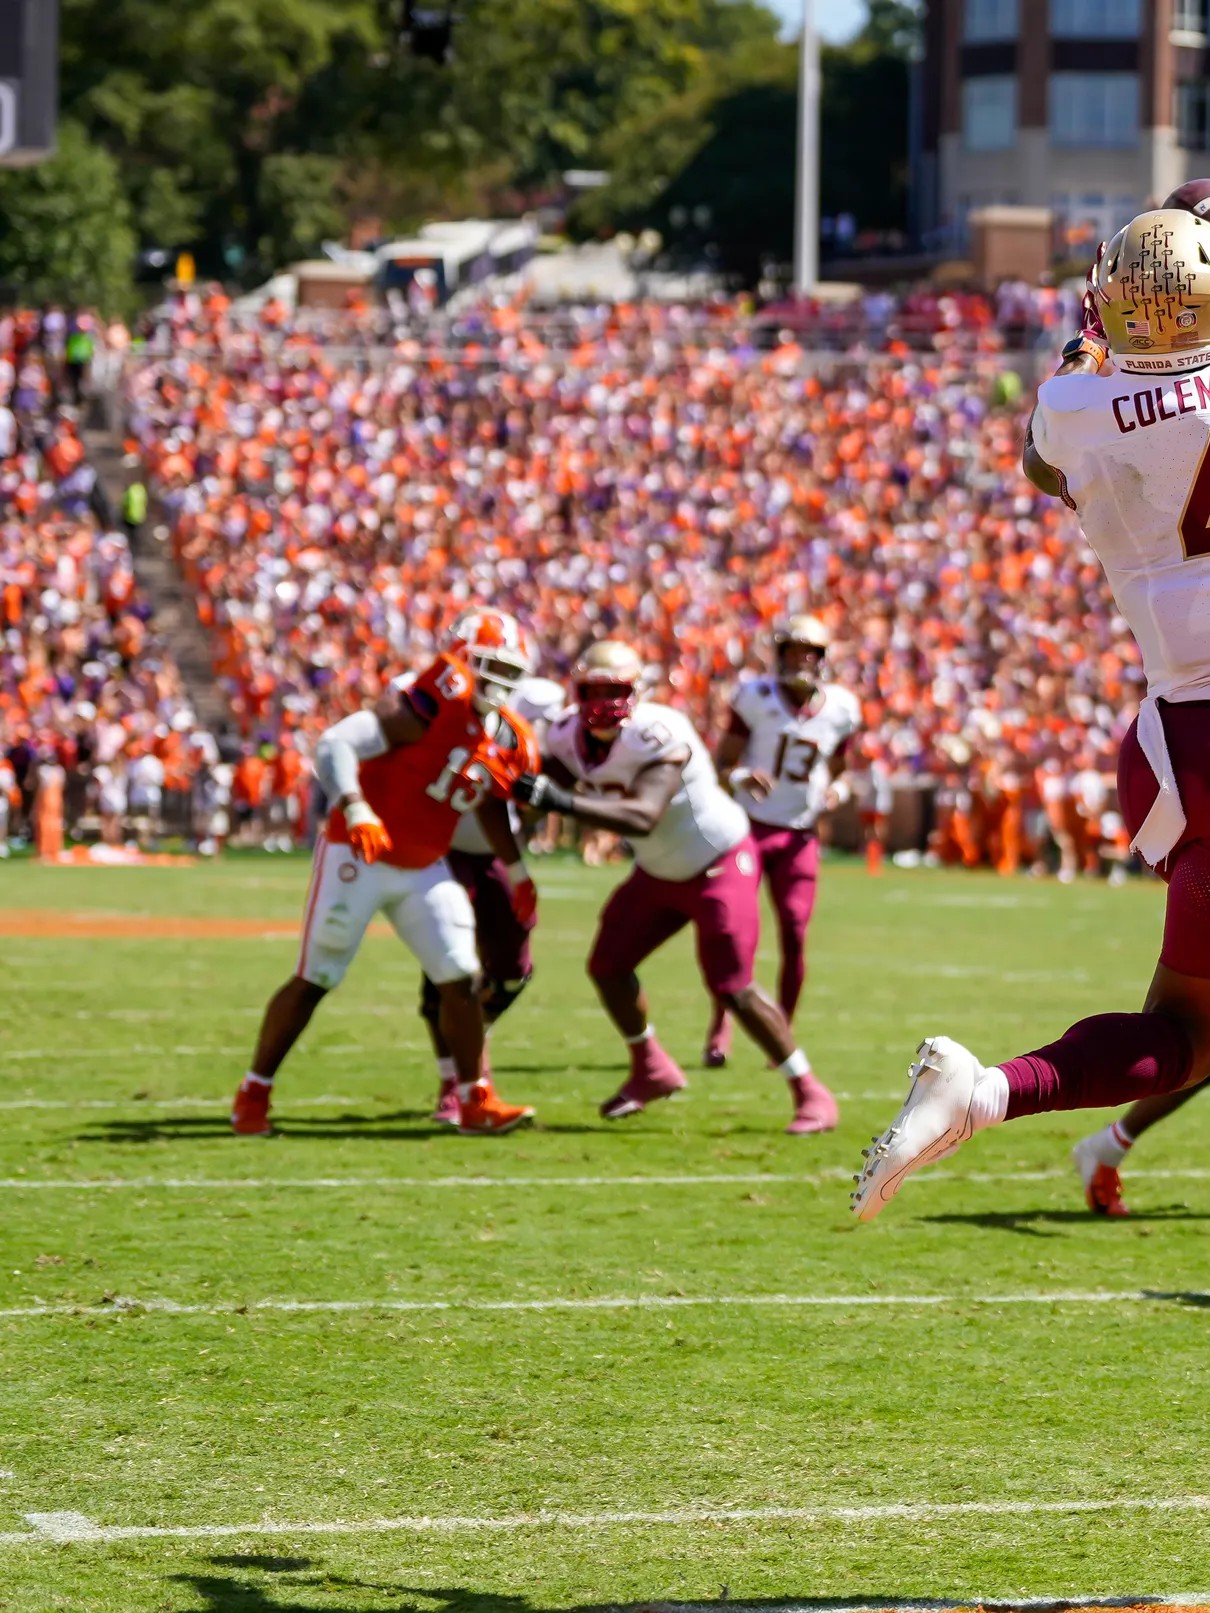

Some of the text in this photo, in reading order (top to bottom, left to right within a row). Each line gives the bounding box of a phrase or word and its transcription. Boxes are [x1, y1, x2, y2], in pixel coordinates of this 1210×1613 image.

[1132, 338, 1150, 346] ACC
[1125, 360, 1172, 369] FLORIDA
[773, 732, 820, 783] 13
[425, 746, 491, 814] 13
